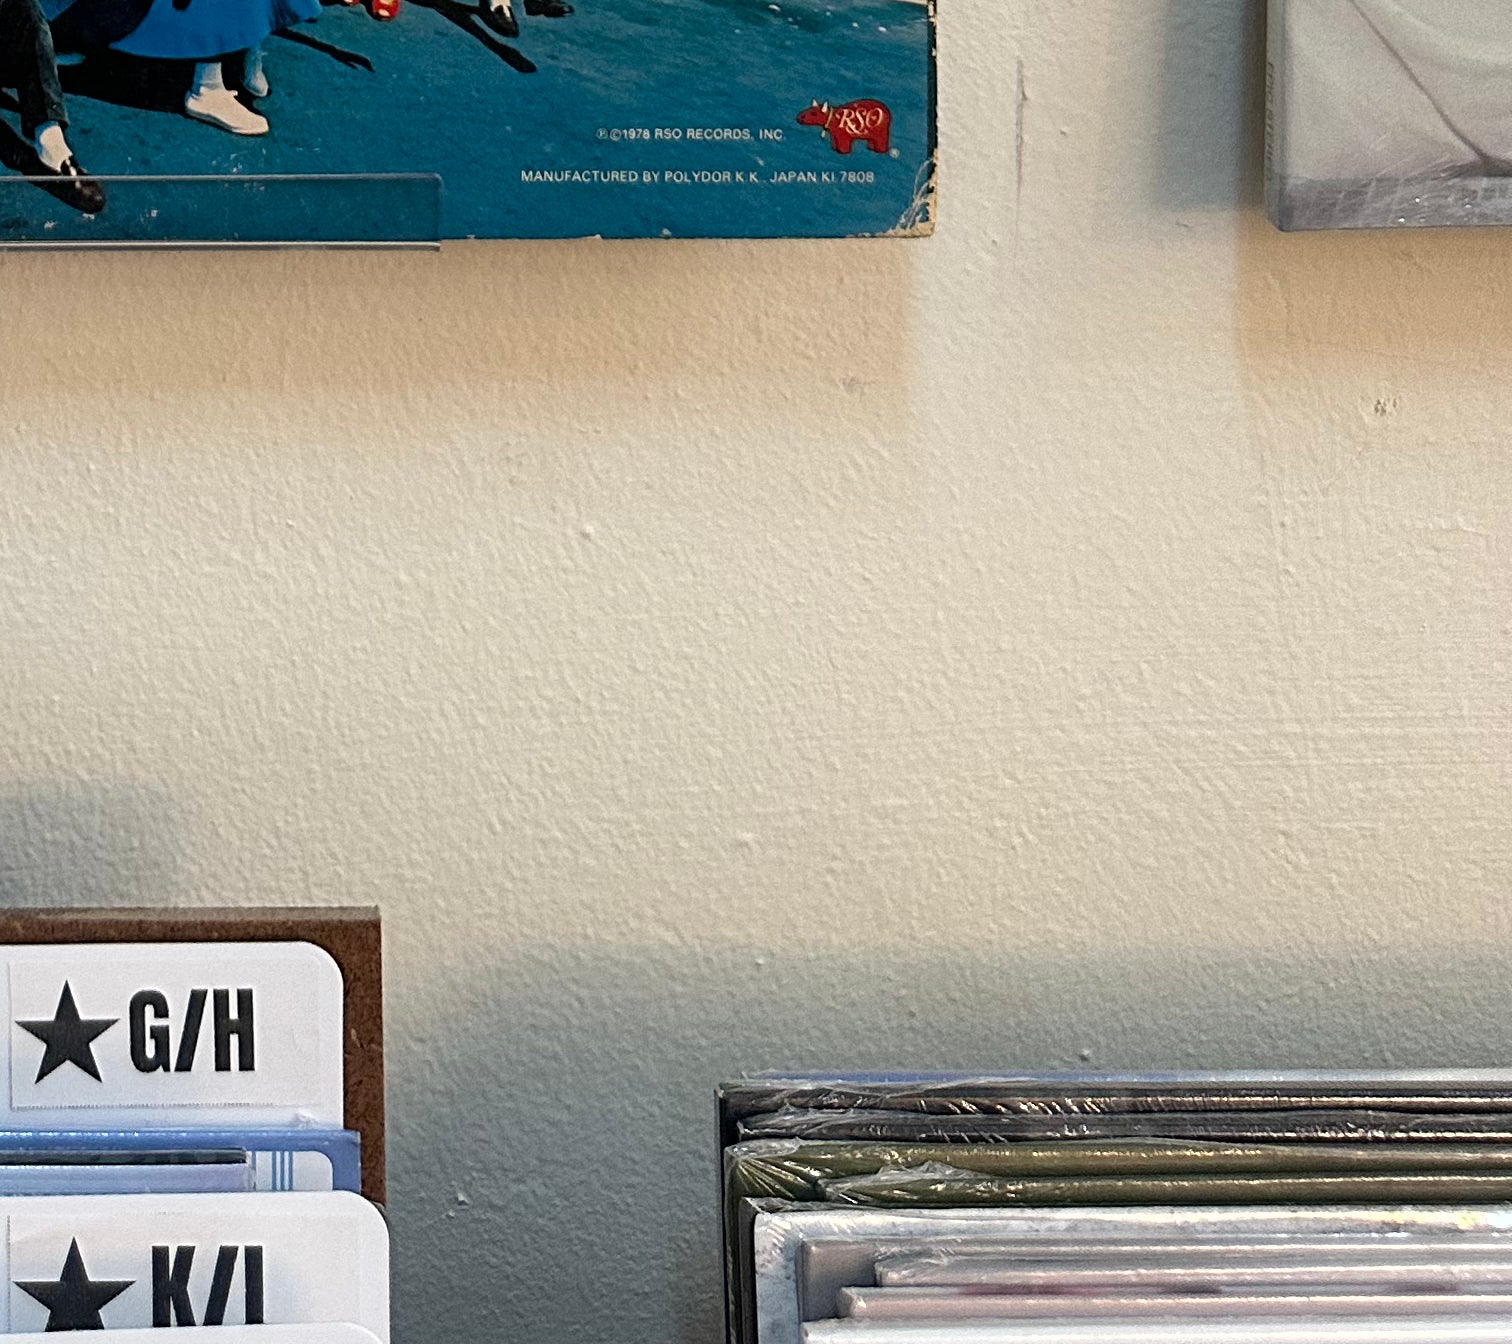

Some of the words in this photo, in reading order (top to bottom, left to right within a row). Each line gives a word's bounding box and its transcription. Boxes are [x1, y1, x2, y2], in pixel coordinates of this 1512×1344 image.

[654, 128, 683, 140] RSO
[521, 170, 638, 183] MANUFACTURED
[642, 170, 661, 183] BY
[664, 170, 732, 183] POLYDOR
[770, 170, 817, 183] JAPAN
[840, 170, 875, 183] 7808
[130, 989, 255, 1073] G/H
